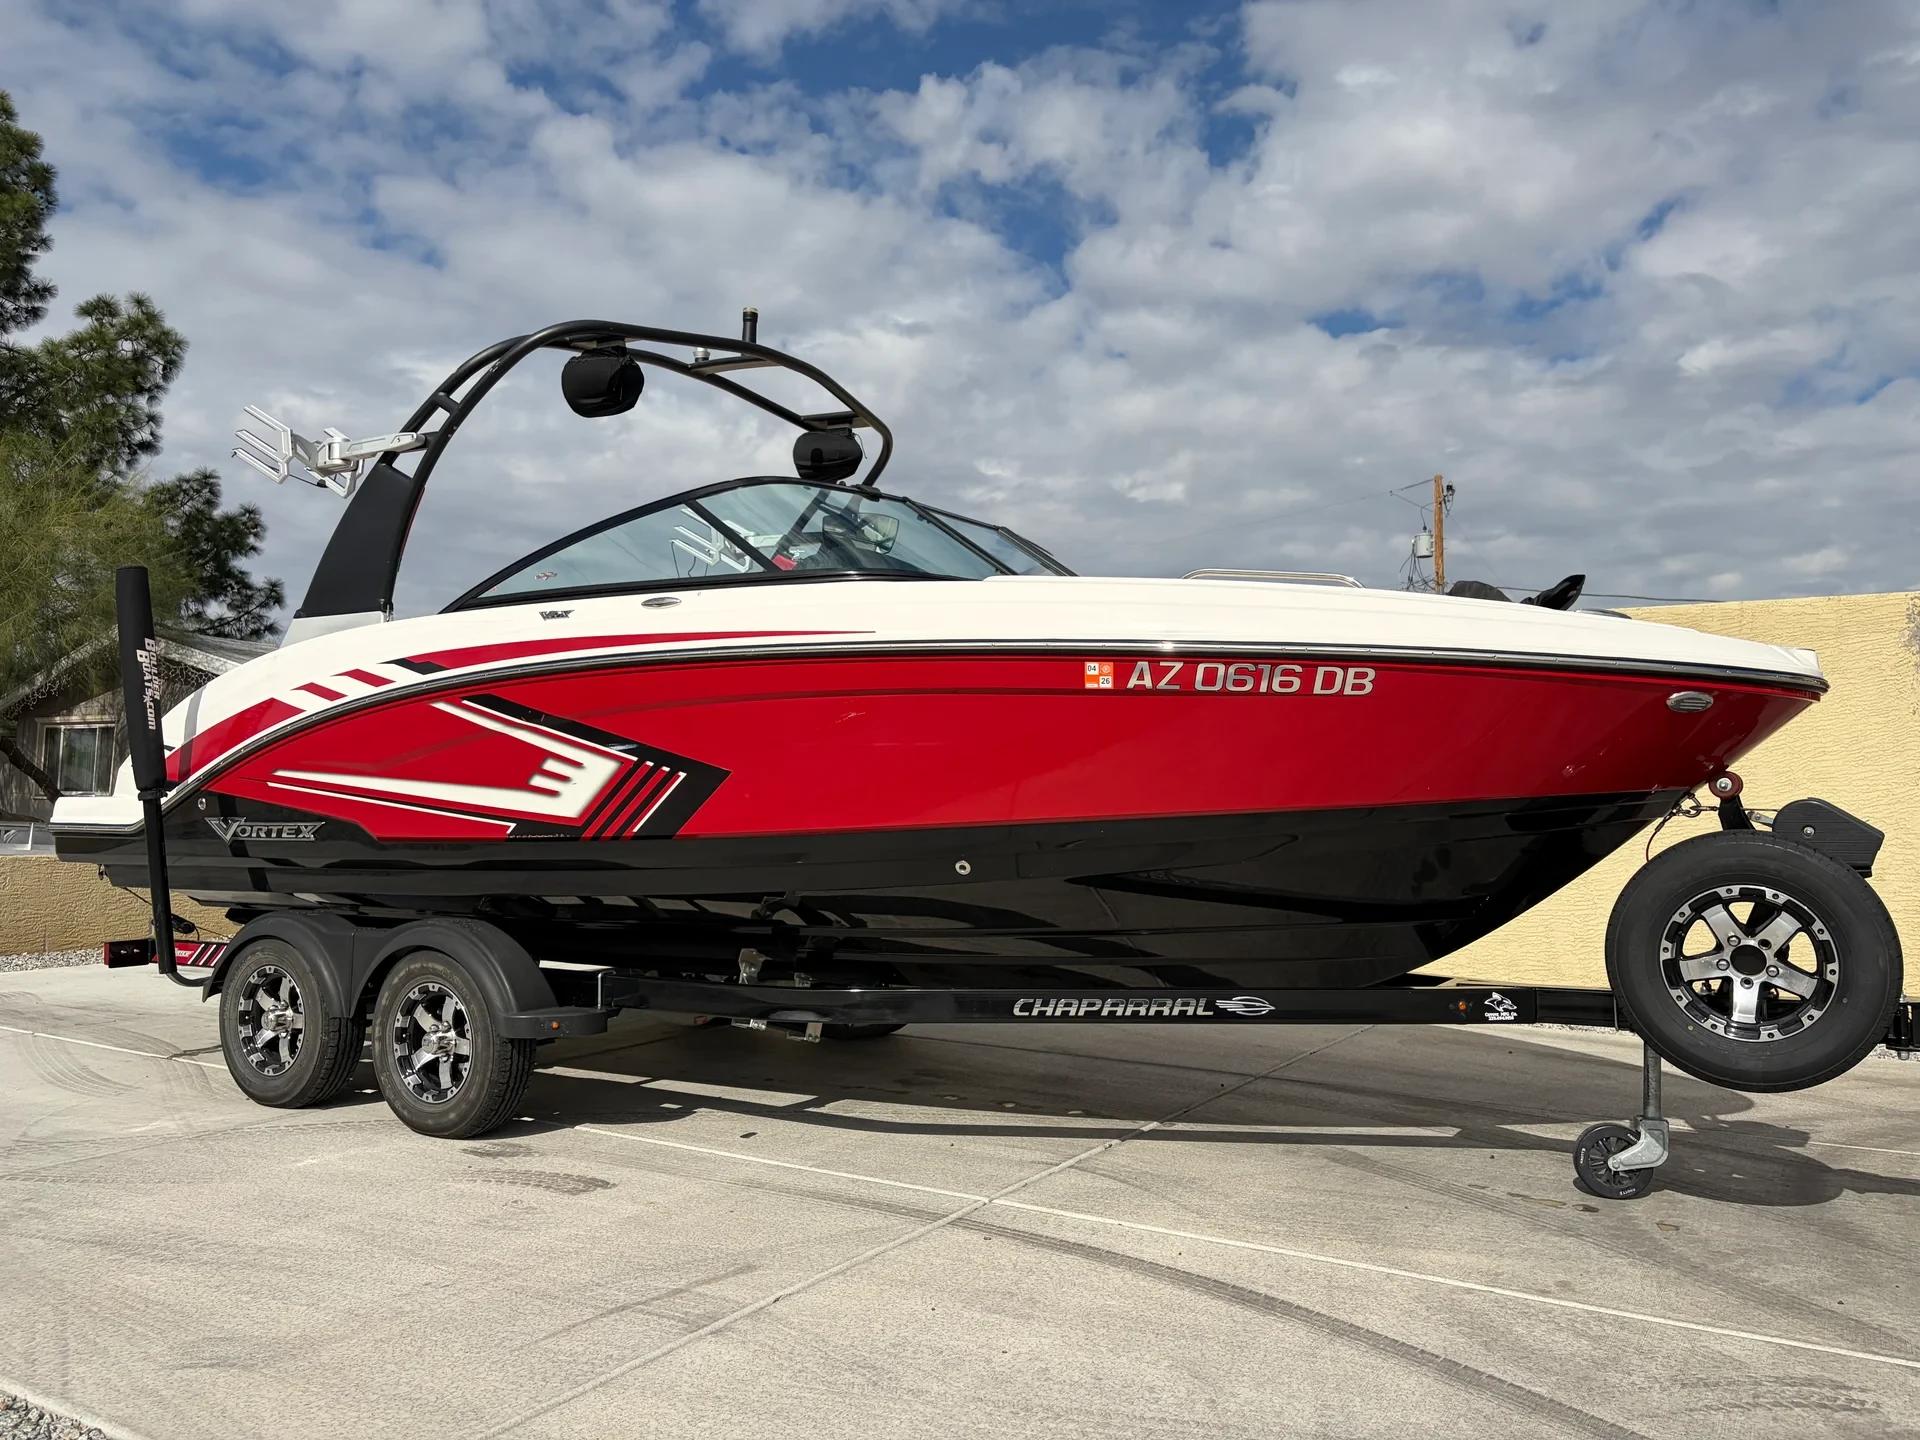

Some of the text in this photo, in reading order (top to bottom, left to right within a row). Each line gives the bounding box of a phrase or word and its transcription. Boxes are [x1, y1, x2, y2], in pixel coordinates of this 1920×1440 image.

[145, 637, 160, 701] BOULDER
[1087, 664, 1097, 672] 04
[1126, 661, 1376, 696] AZ 0616 DB
[1101, 677, 1111, 685] 26
[204, 816, 324, 846] VORTEX
[1013, 997, 1214, 1016] CHAPARRAL
